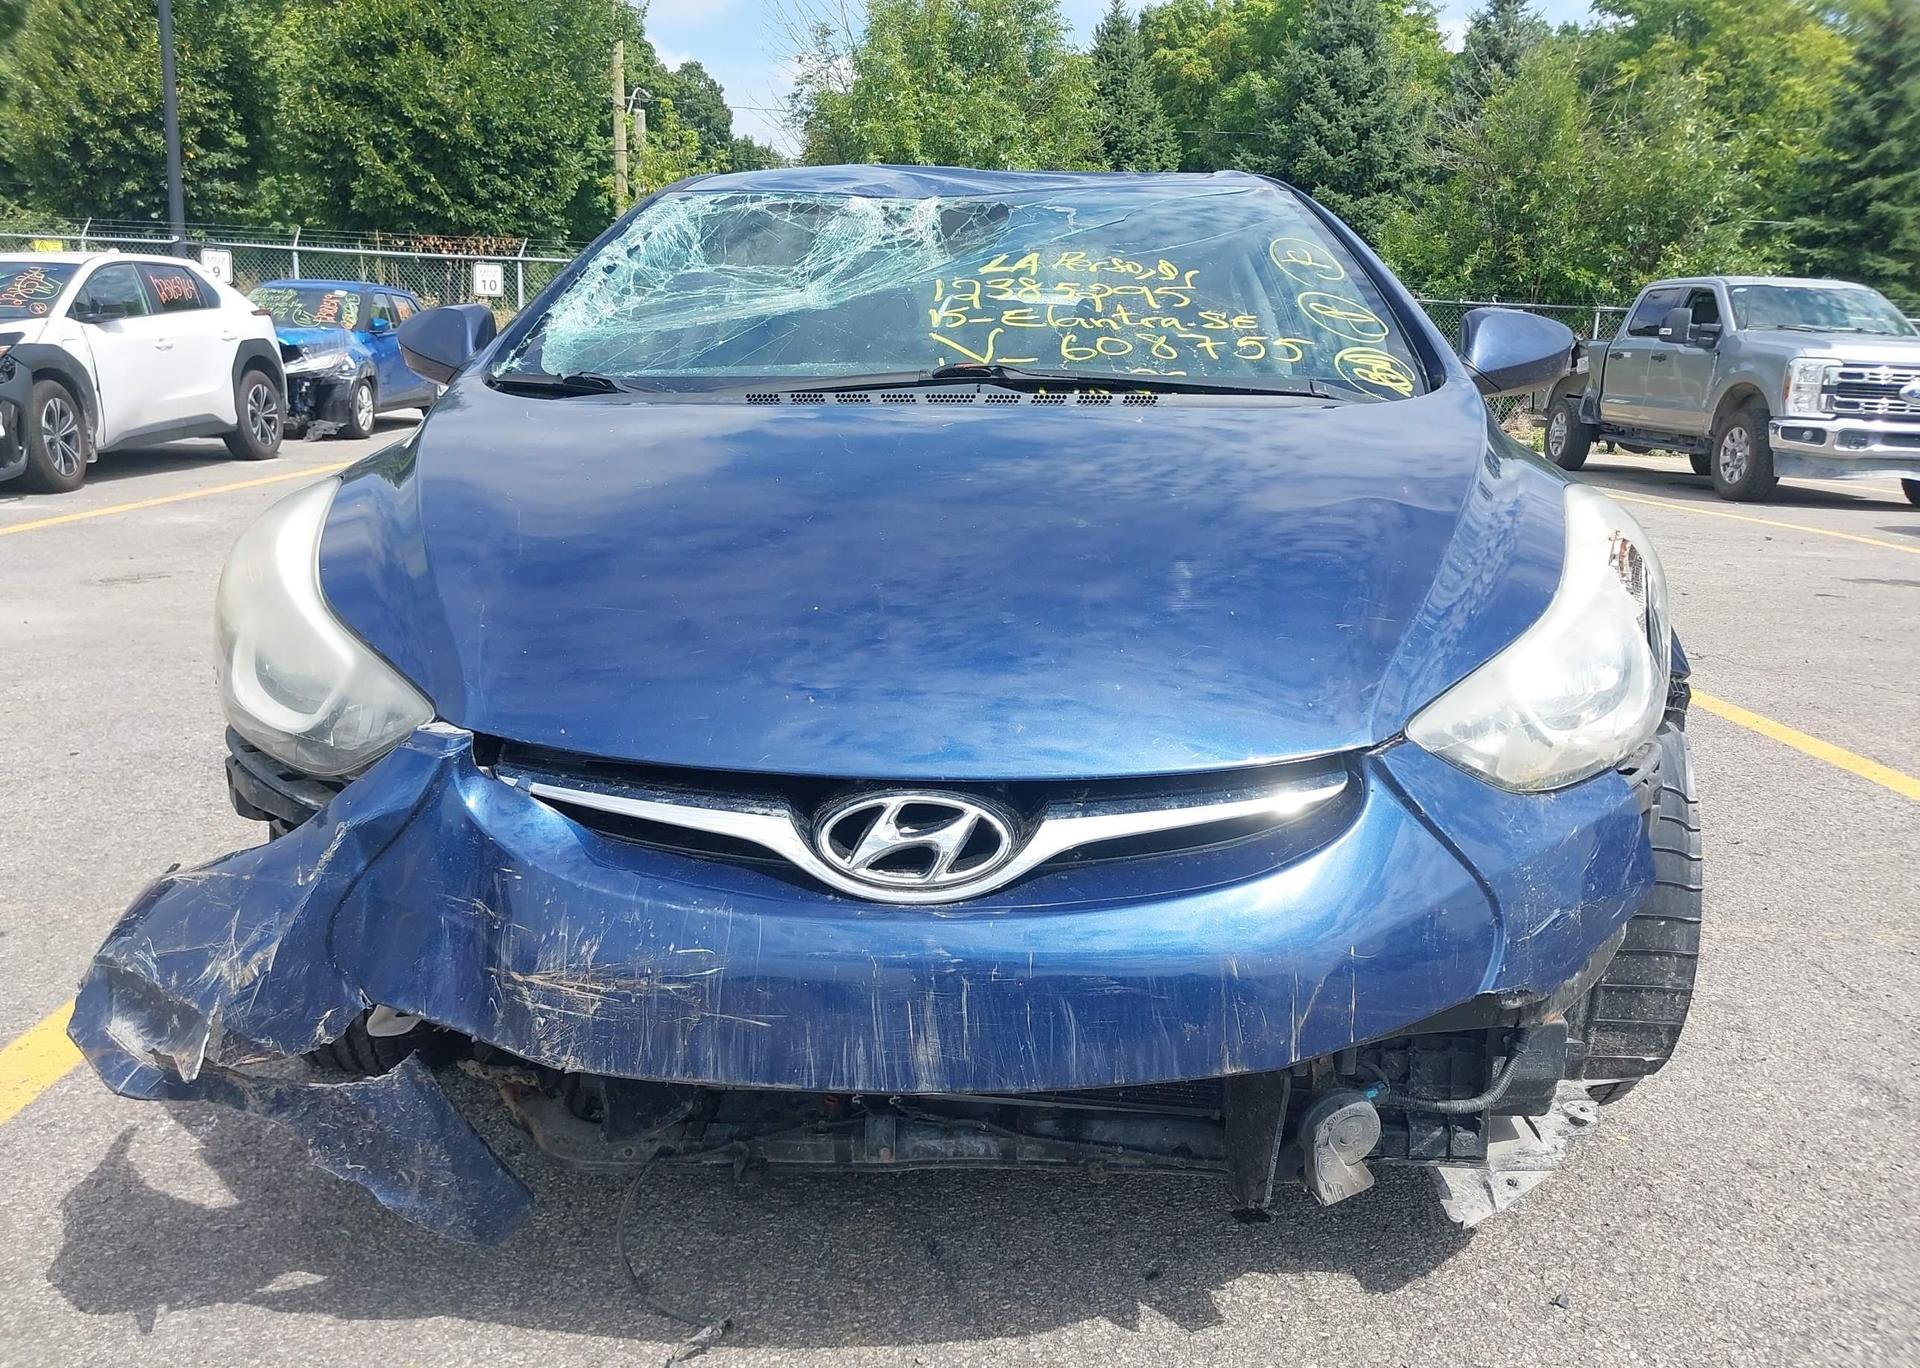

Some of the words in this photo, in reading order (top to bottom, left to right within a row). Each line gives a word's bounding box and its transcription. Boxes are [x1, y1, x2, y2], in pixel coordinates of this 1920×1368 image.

[212, 266, 221, 278] 9
[481, 279, 497, 291] 10
[1061, 332, 1316, 362] 608755
